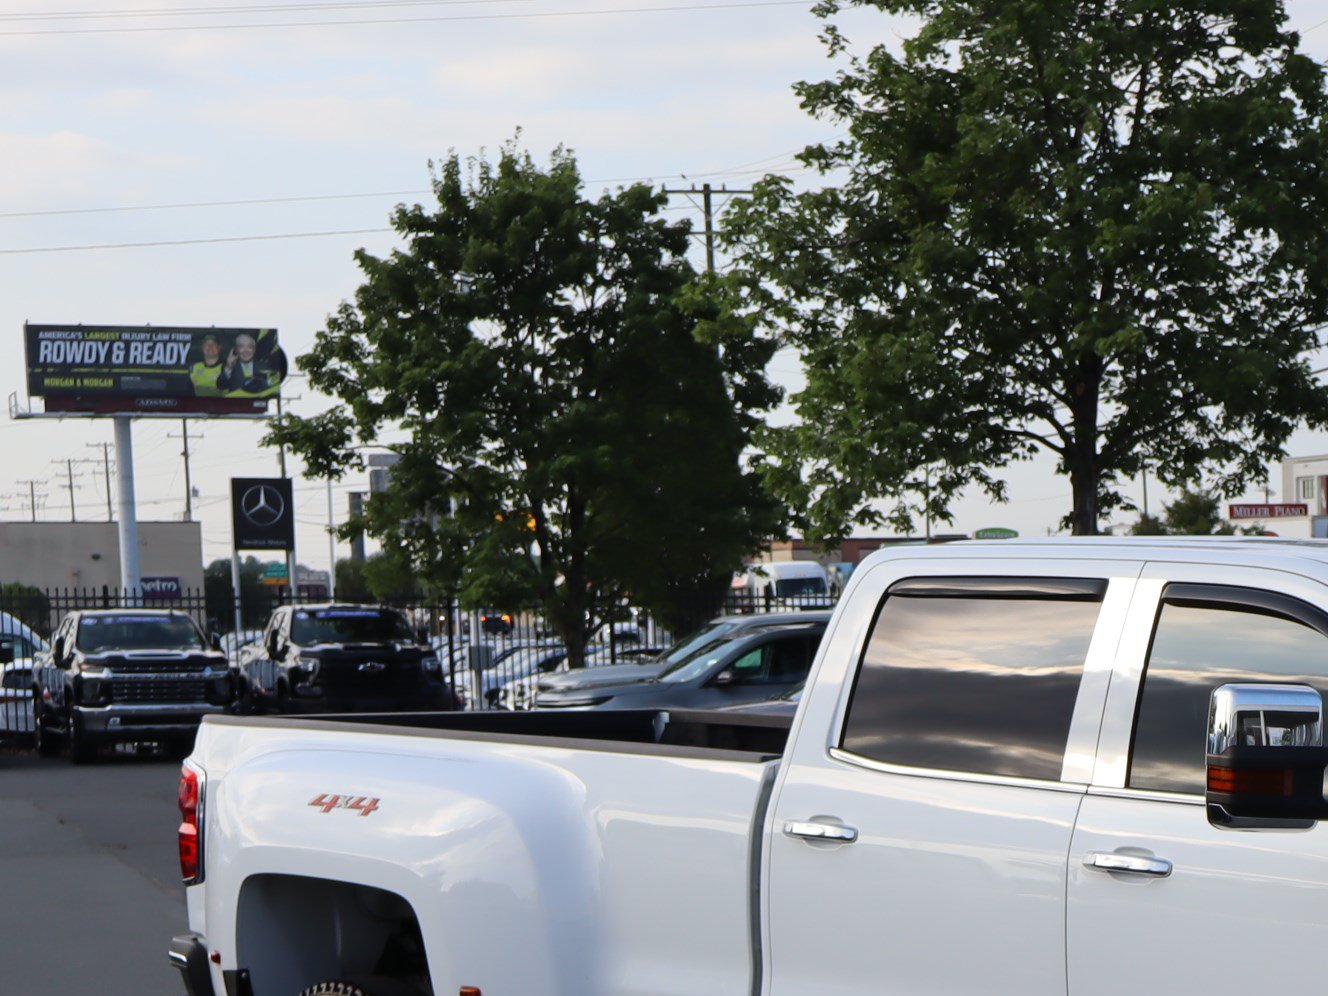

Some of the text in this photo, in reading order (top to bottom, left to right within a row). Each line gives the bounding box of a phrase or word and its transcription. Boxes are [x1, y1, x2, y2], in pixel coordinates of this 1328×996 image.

[39, 341, 192, 365] ROWDY & READY
[1233, 505, 1306, 517] MILLER PIANO
